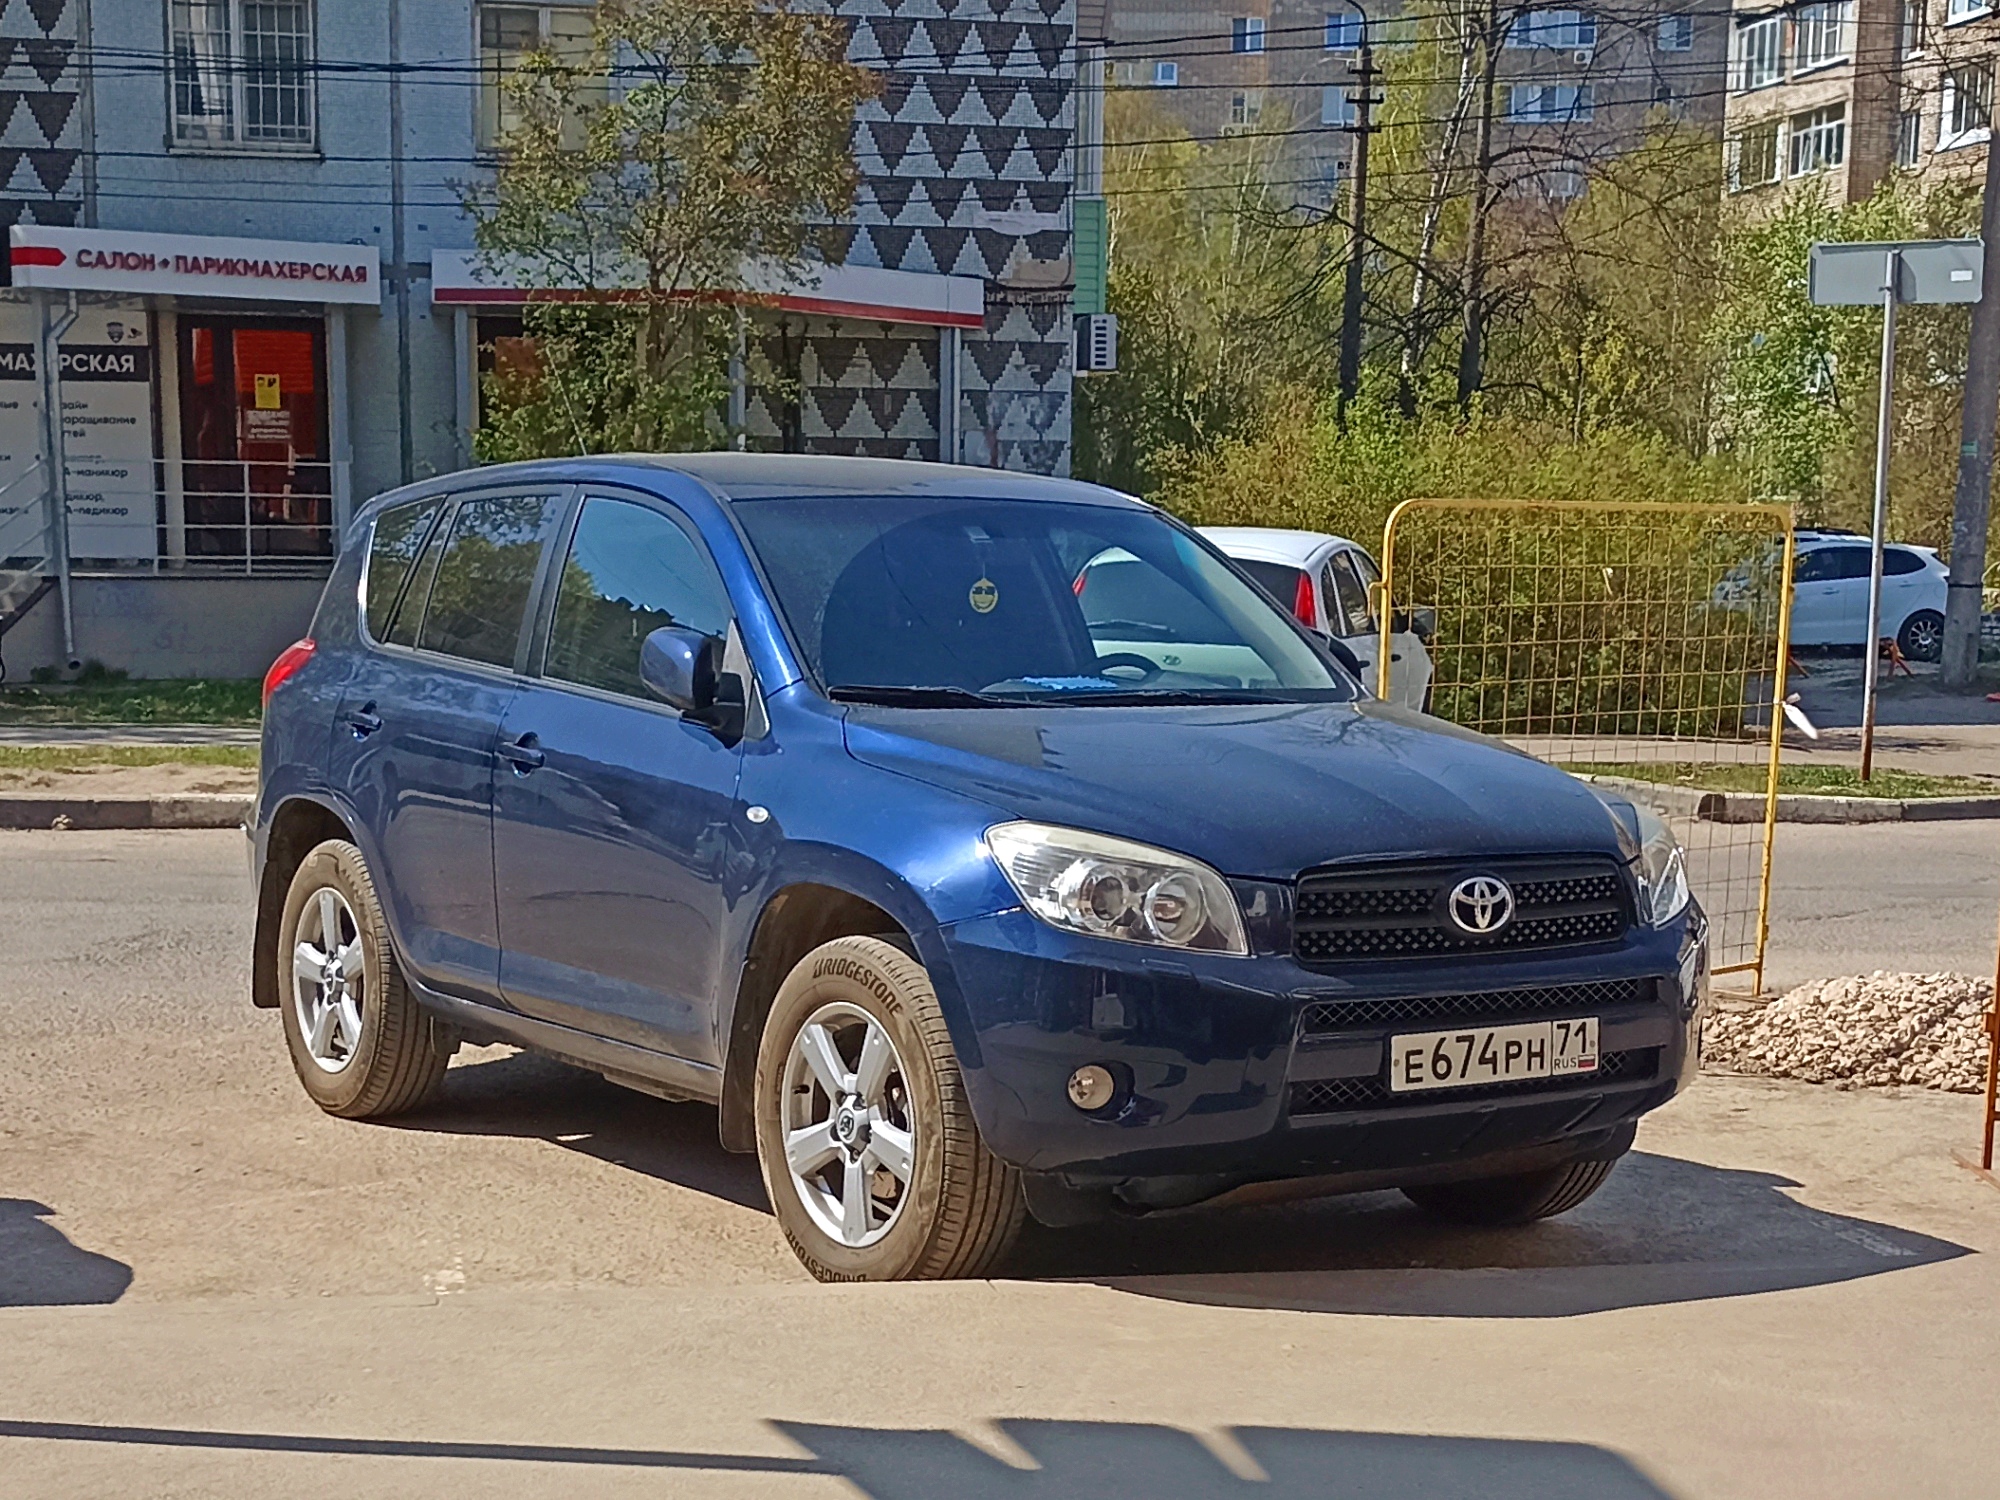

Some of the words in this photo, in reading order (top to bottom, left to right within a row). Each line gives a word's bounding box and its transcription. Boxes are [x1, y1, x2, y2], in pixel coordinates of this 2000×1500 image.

[75, 248, 156, 272] САЛОН
[174, 254, 368, 283] ПАРИКМАХЕРСКАЯ
[0, 352, 135, 373] МАРСКАЯ
[63, 415, 137, 426] аращивание
[812, 956, 904, 1019] BRIDGESTONE
[1556, 1021, 1588, 1056] 71
[1553, 1057, 1577, 1070] RUS
